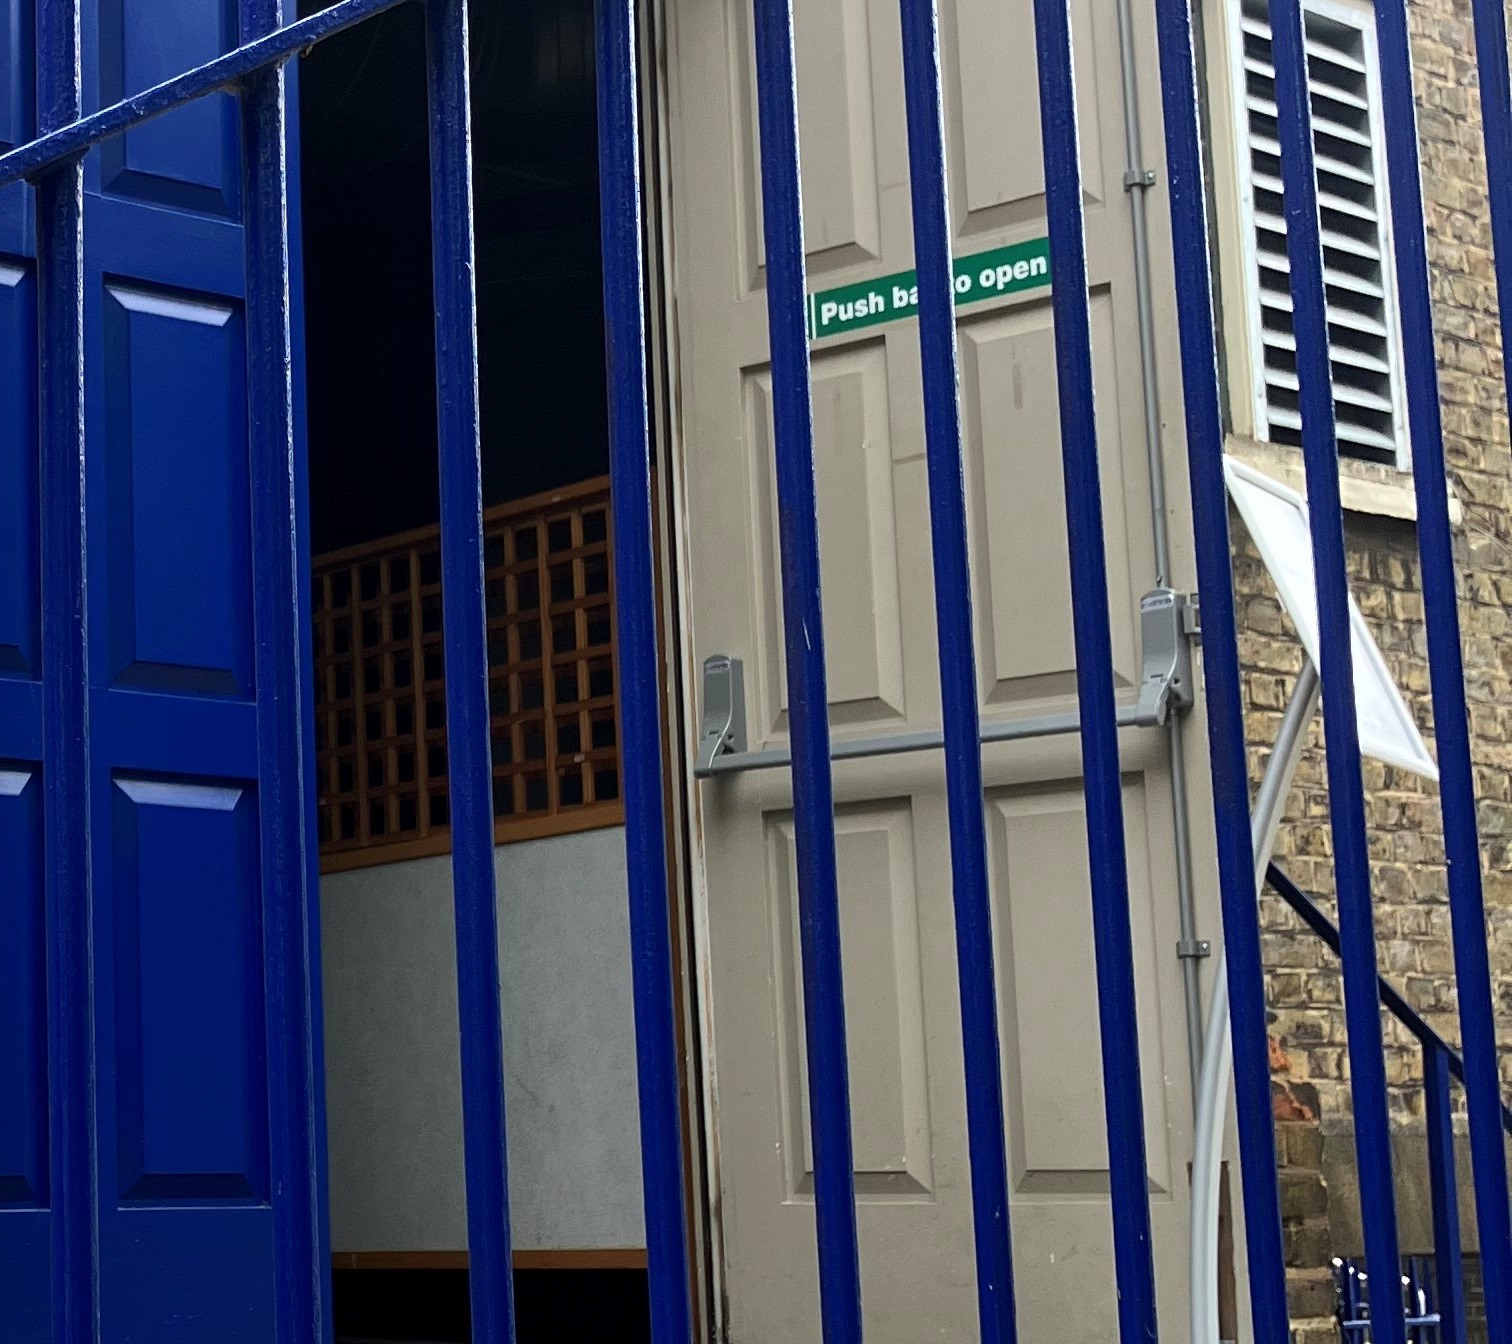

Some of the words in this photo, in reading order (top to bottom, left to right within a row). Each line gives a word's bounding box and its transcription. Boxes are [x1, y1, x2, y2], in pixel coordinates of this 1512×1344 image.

[821, 291, 885, 326] Push
[892, 286, 919, 309] ba
[953, 274, 972, 294] o
[979, 256, 1048, 291] open
